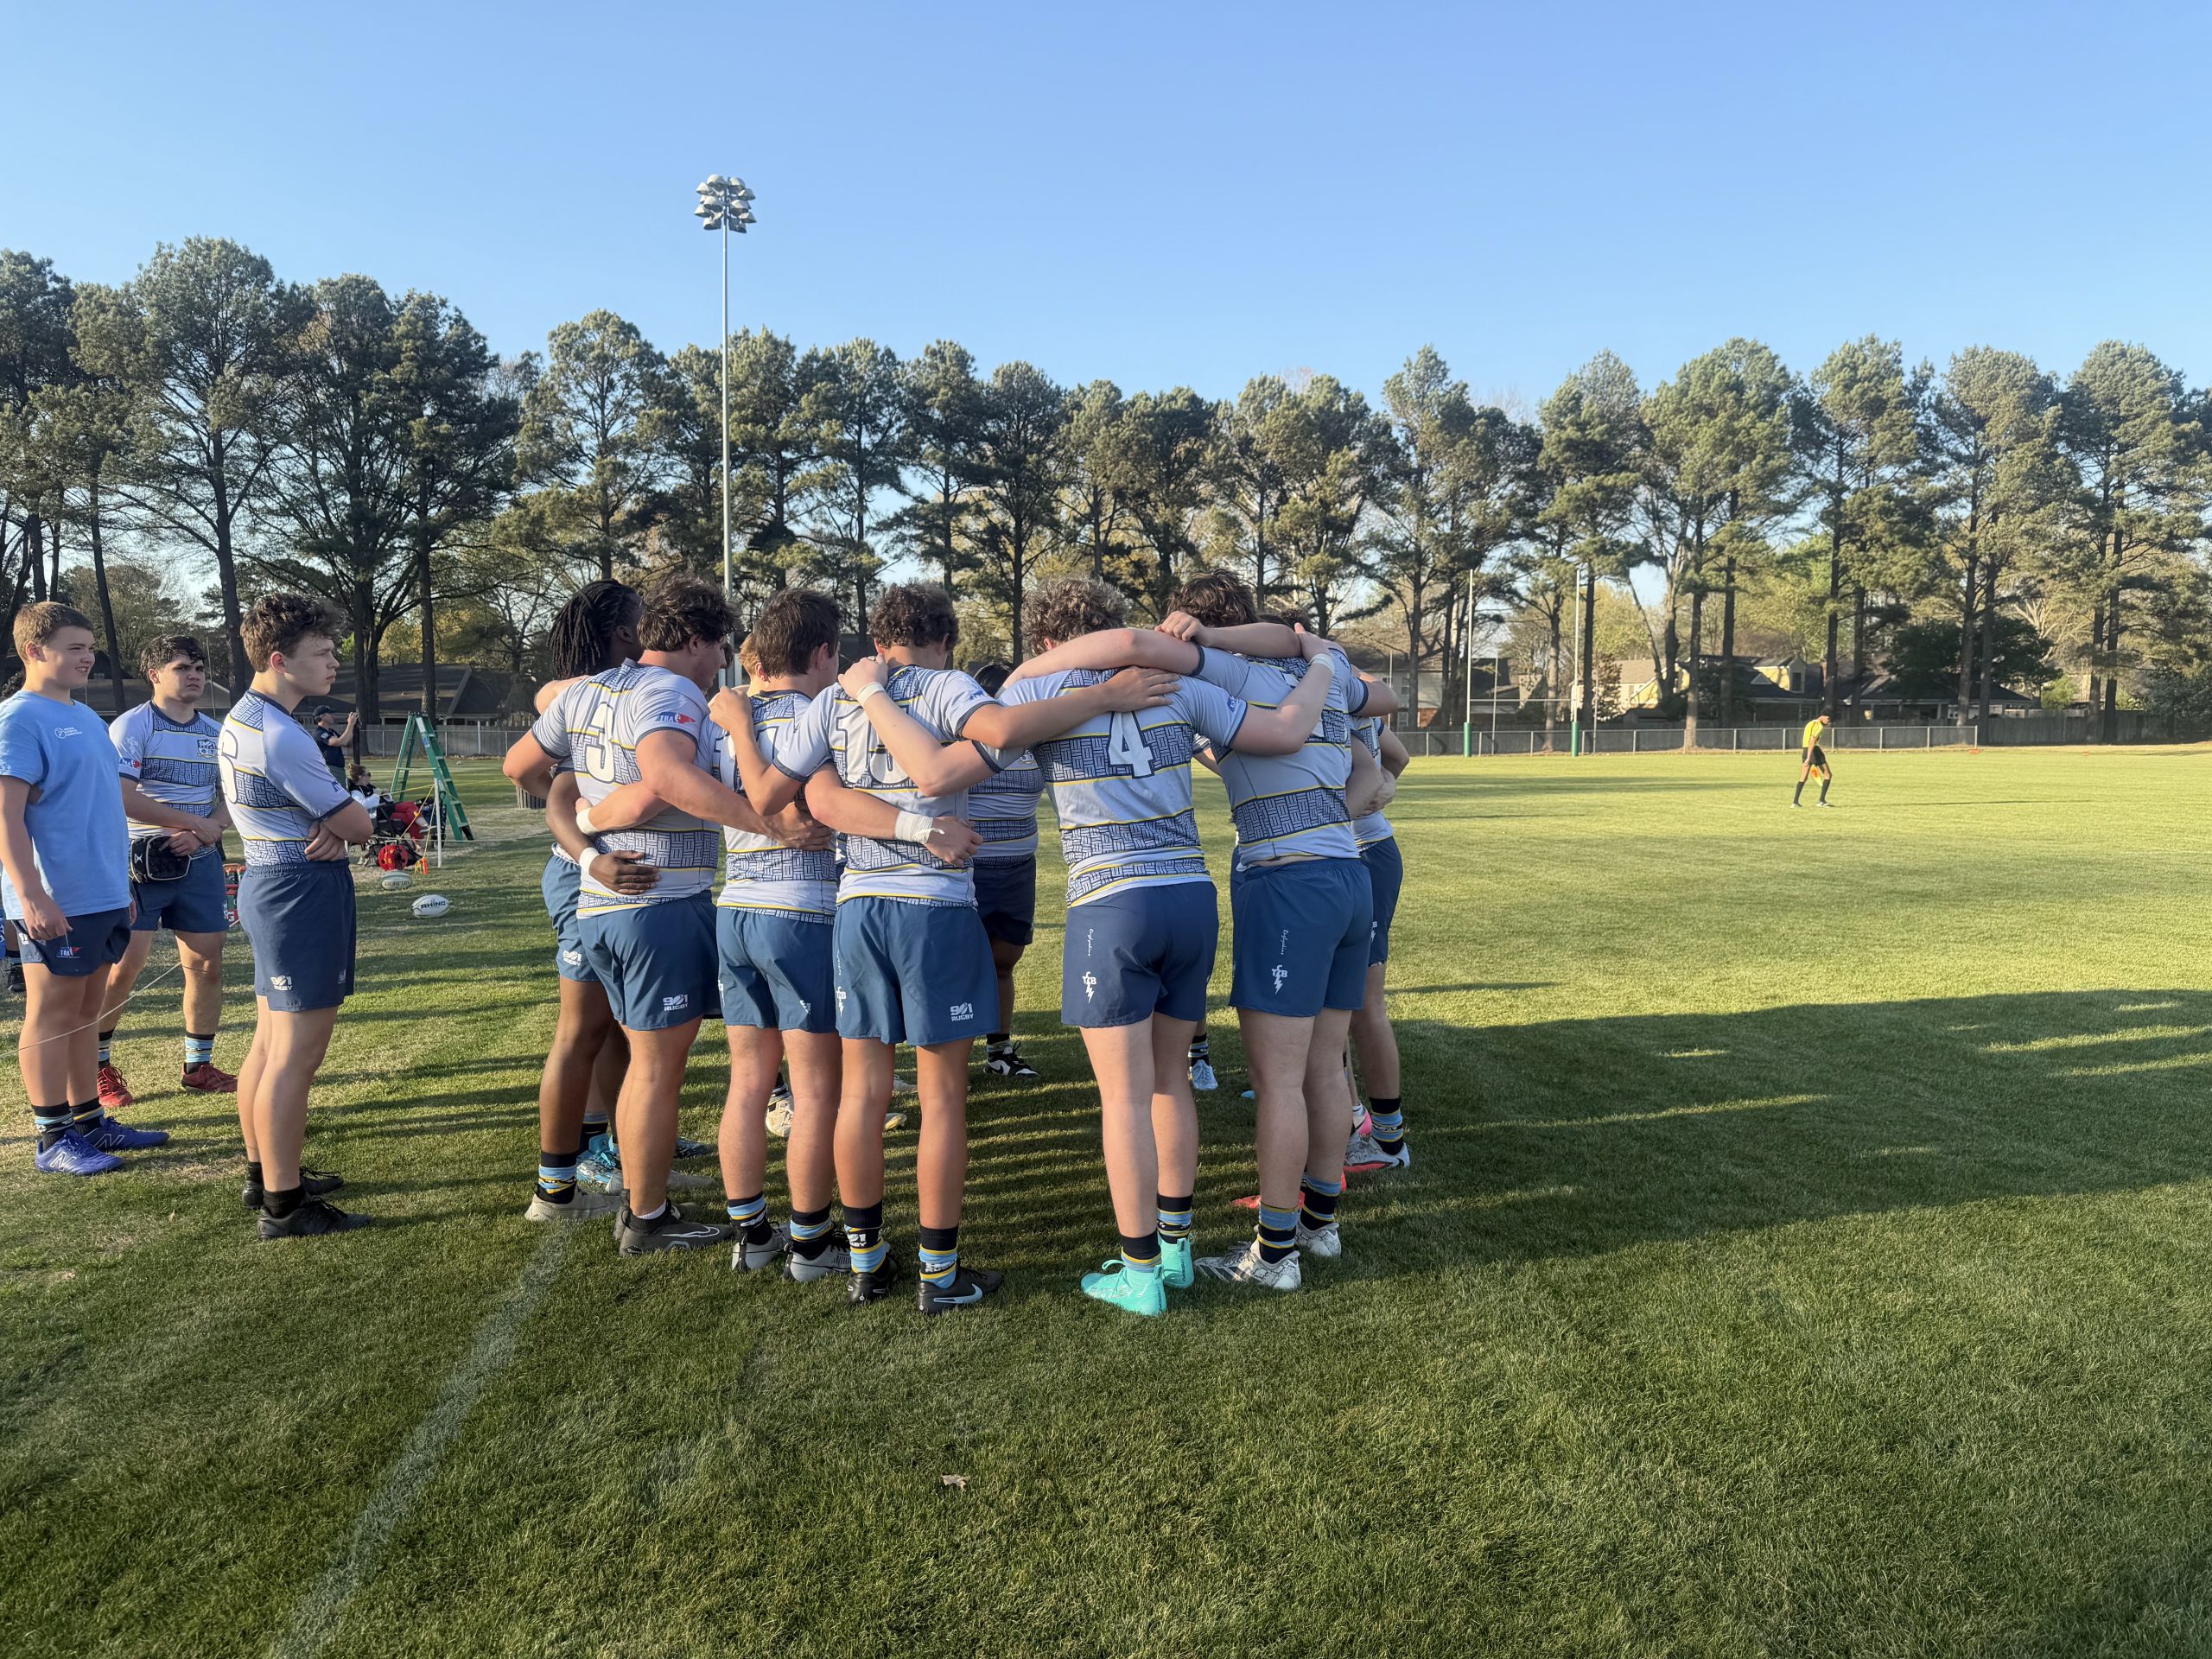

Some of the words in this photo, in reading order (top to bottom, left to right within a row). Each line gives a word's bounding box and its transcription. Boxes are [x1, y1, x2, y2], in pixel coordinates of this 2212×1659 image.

[585, 701, 615, 784] 3
[1107, 710, 1155, 779] 4
[420, 901, 447, 910] RHINO
[664, 1002, 689, 1012] RUGBY
[950, 1002, 974, 1016] 901
[950, 1013, 974, 1021] RUGBY
